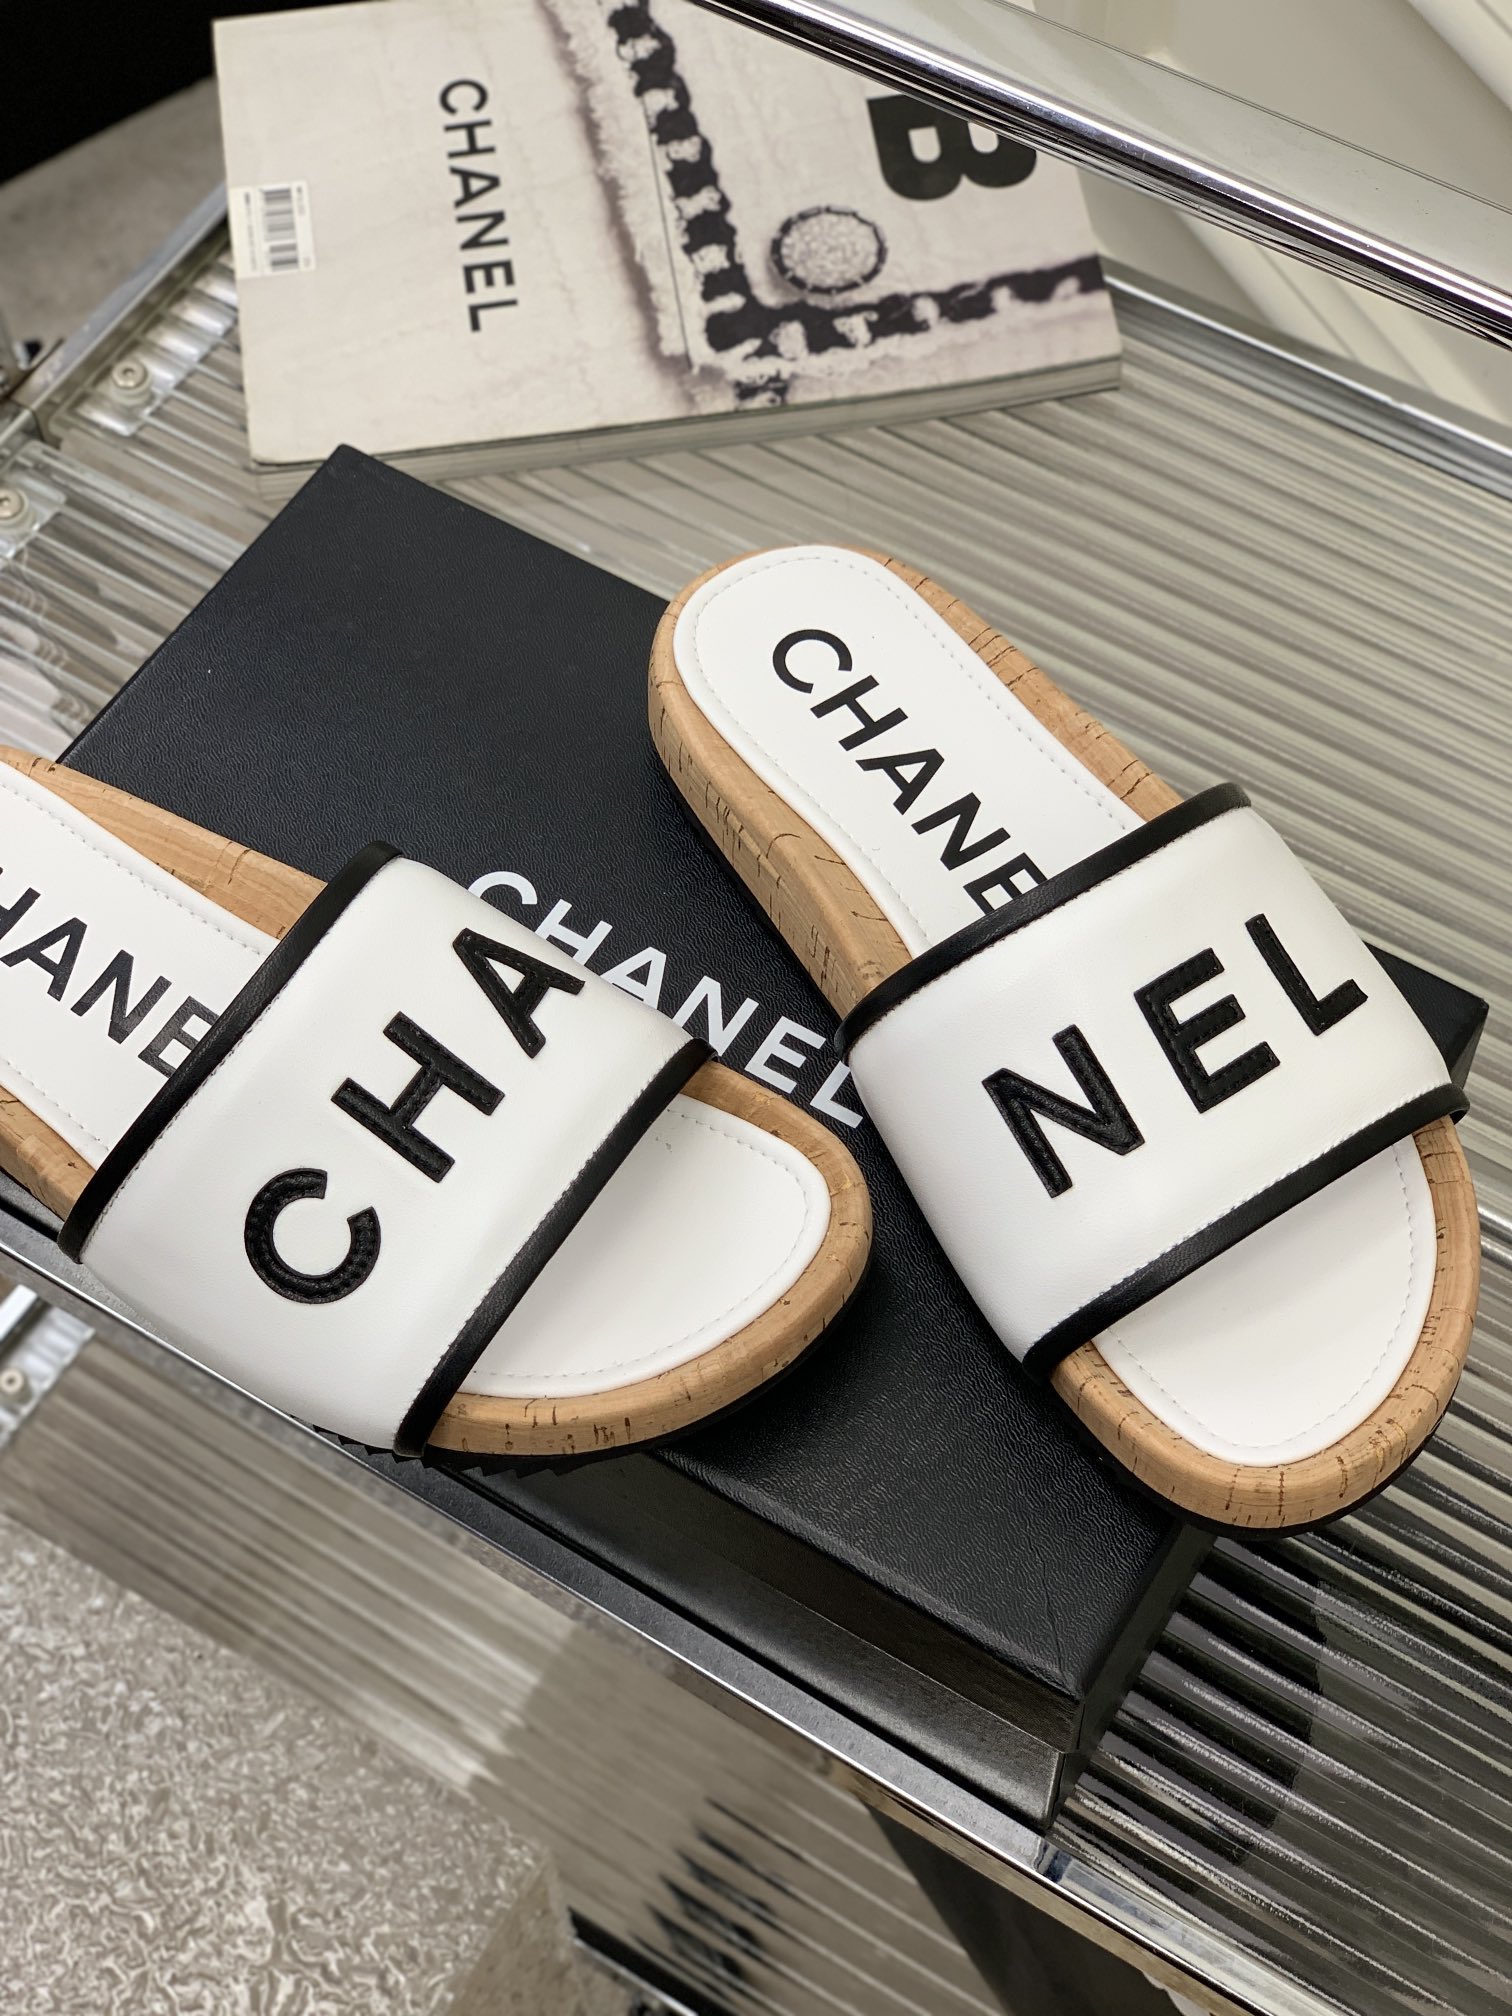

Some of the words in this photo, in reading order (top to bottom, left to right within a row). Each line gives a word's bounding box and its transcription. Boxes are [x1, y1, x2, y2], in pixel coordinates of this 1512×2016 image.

[439, 78, 518, 333] CHANEL
[244, 928, 585, 1304] CHA
[982, 914, 1368, 1198] NEL
